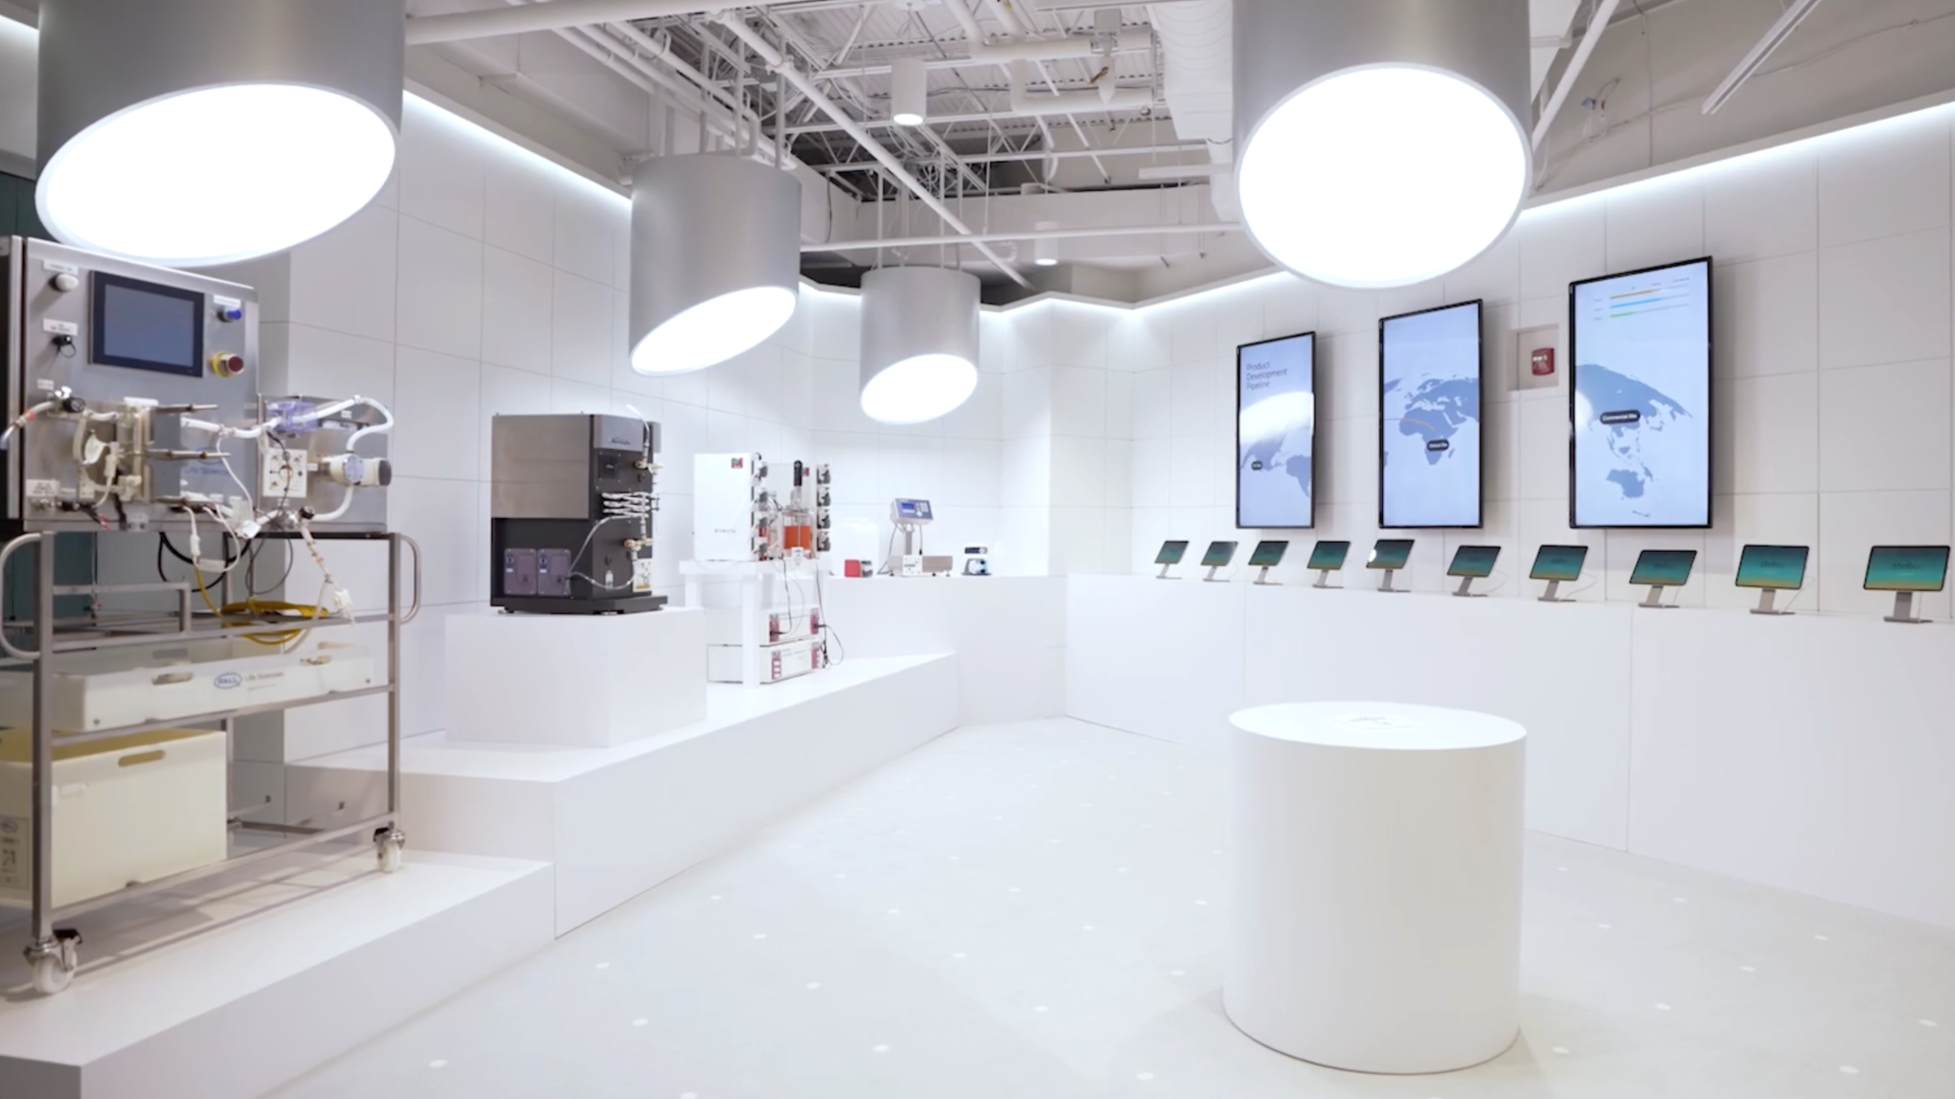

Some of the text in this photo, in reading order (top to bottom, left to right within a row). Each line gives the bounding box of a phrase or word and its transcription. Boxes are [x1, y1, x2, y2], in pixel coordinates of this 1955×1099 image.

[1246, 361, 1270, 370] Product
[1246, 368, 1288, 381] Development
[1246, 381, 1270, 391] Pipeline
